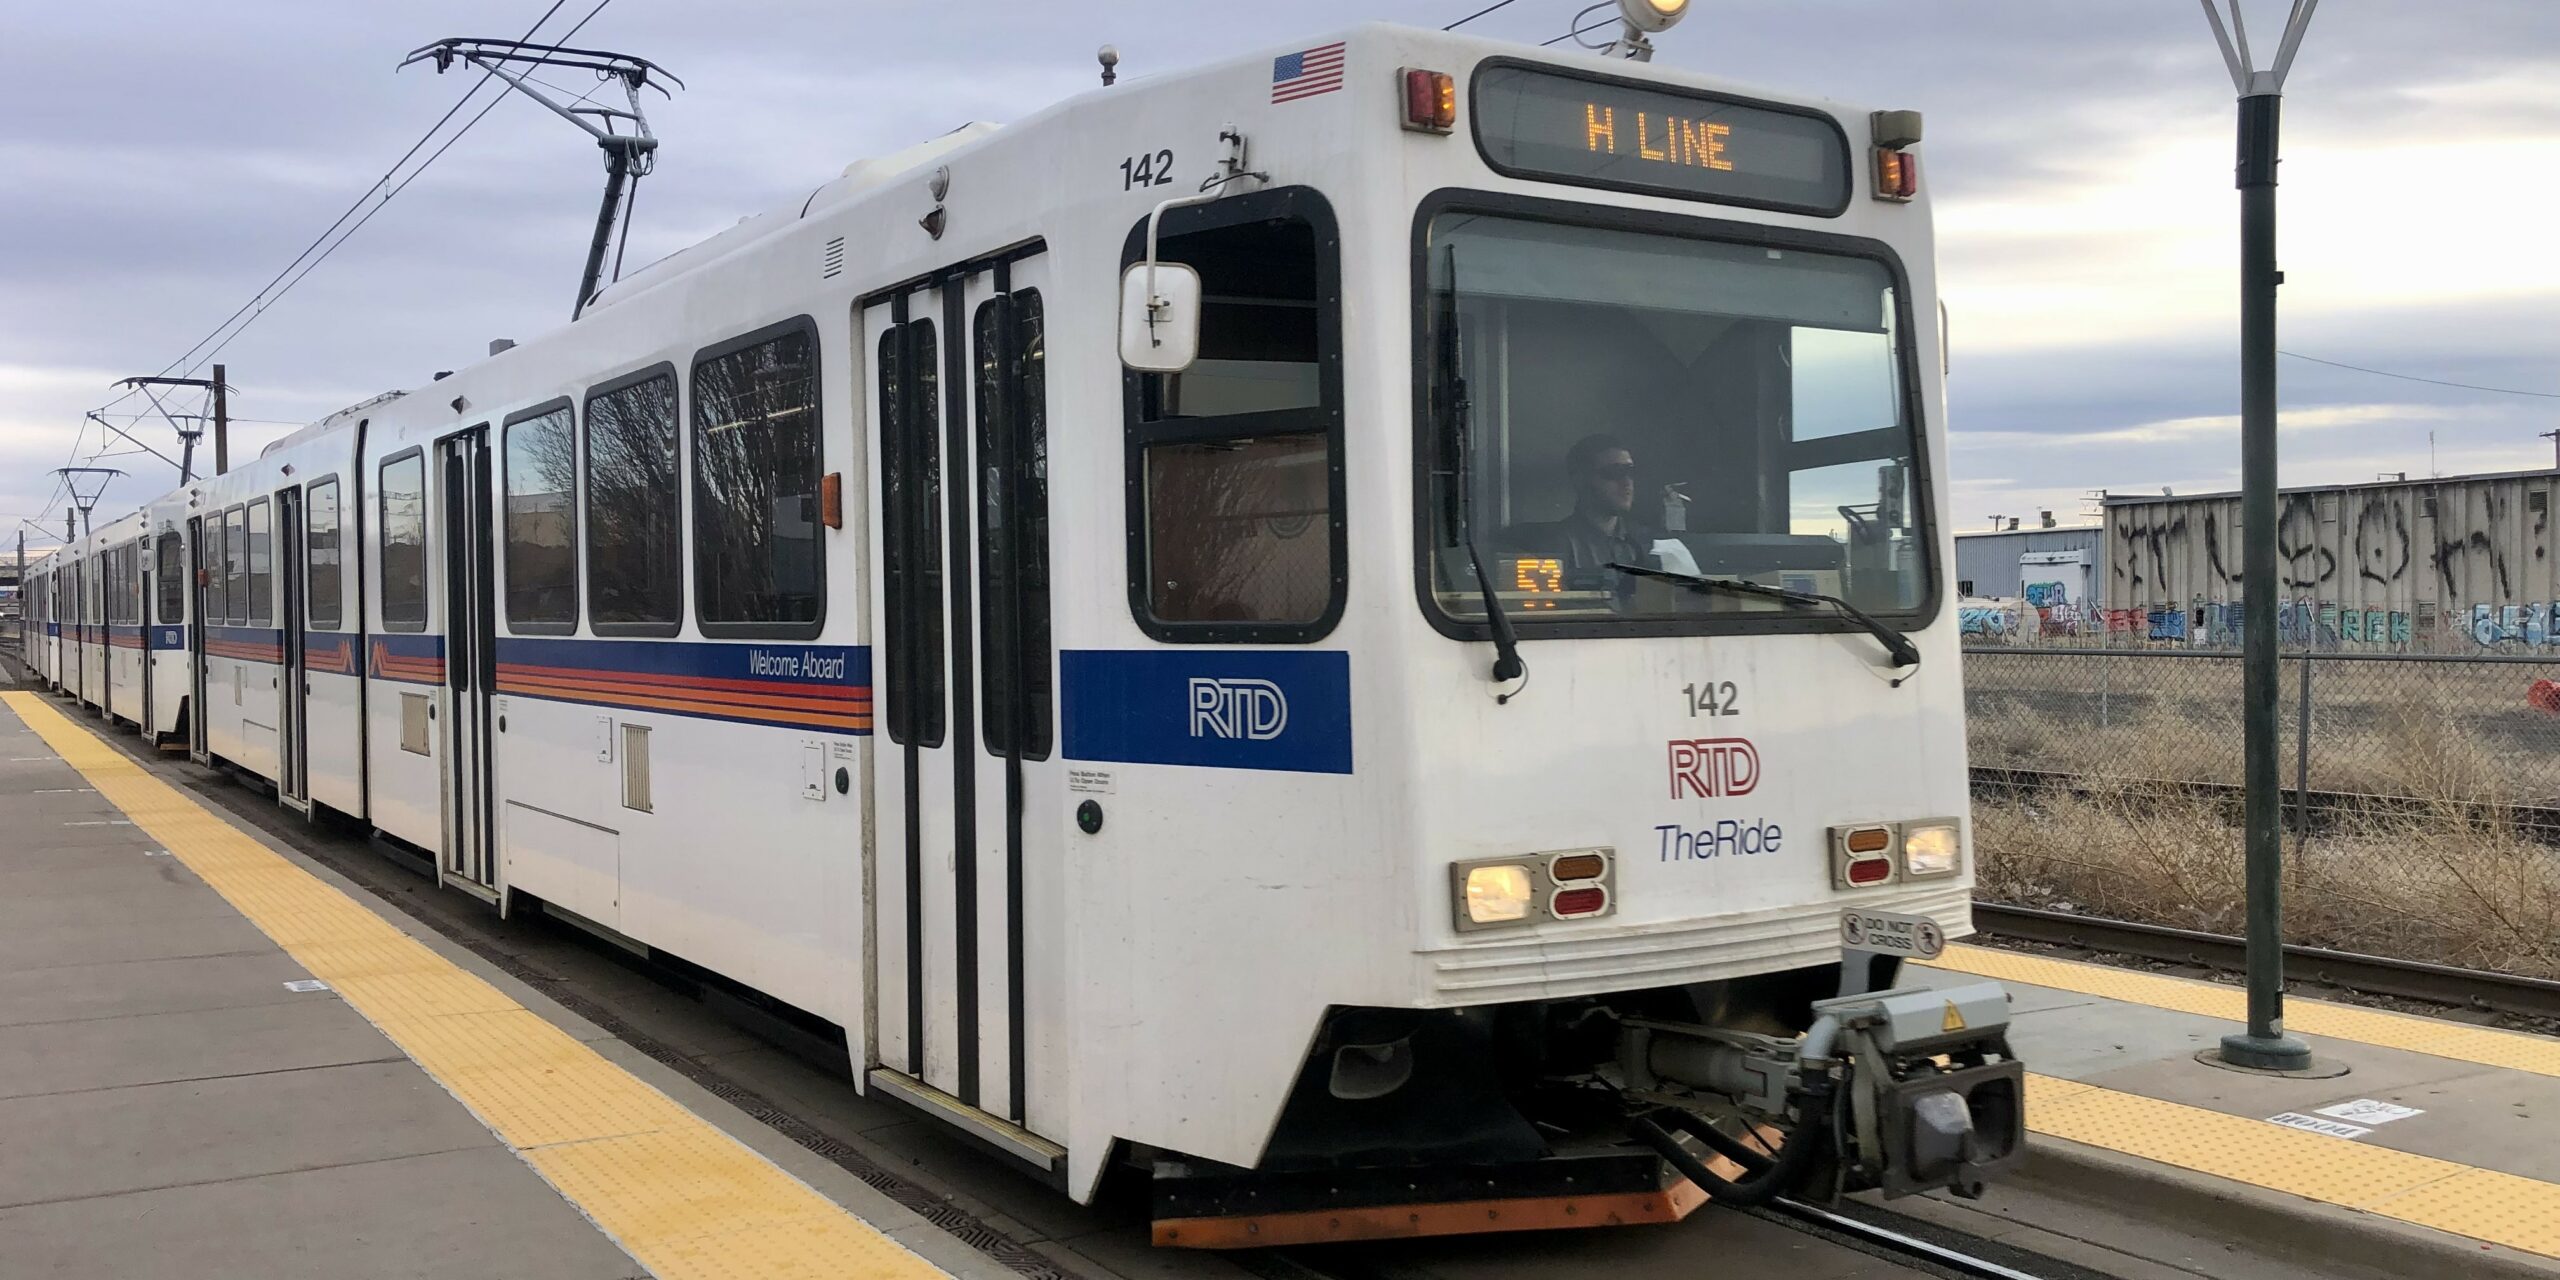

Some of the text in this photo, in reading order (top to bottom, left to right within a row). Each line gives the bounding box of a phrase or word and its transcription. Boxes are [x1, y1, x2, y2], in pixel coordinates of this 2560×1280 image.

[1587, 103, 1734, 172] H LINE
[1119, 148, 1174, 192] 142
[749, 649, 845, 679] Welcome Aboard
[1188, 677, 1289, 741] RTD
[1682, 680, 1740, 718] 142
[1667, 737, 1761, 800] RTD
[1654, 817, 1783, 862] TheRide
[1863, 917, 1915, 934] DO NOT
[1868, 933, 1914, 950] CROSS
